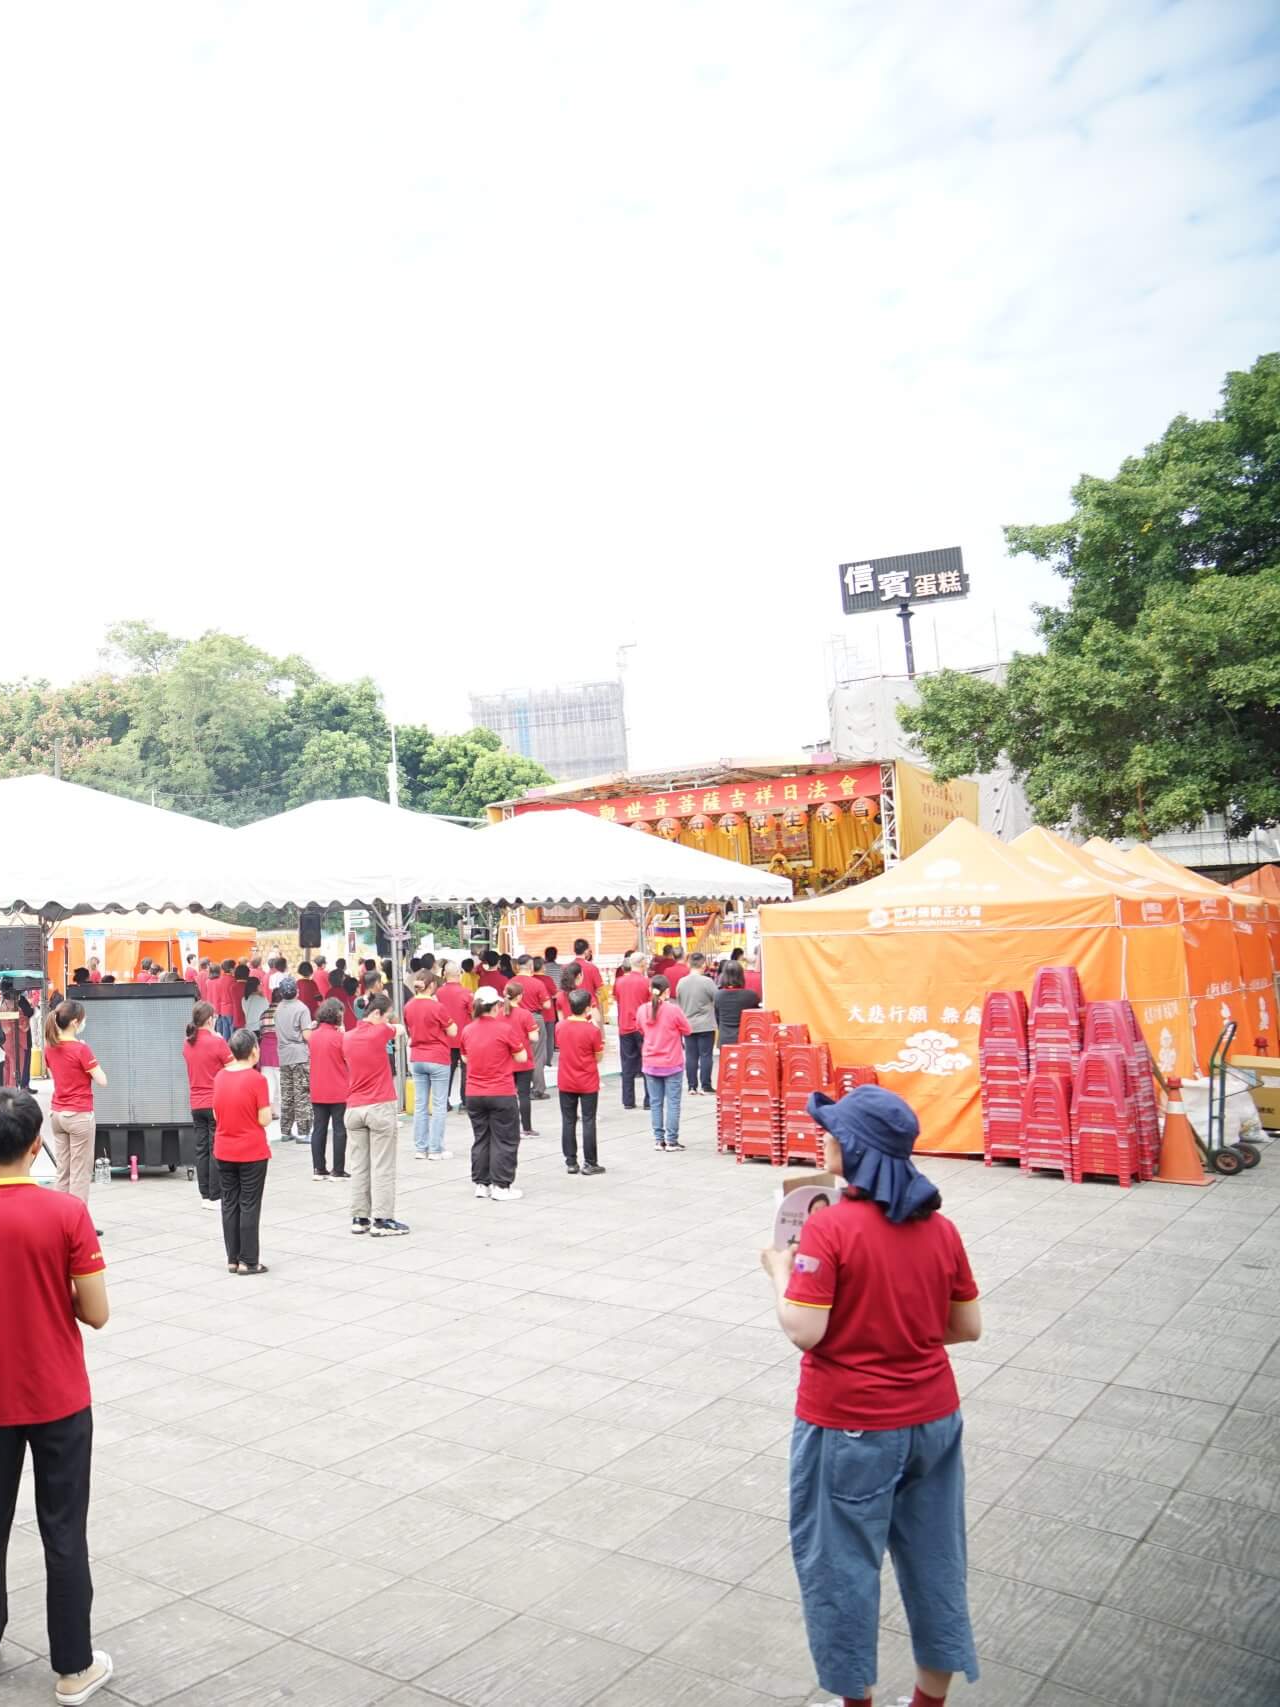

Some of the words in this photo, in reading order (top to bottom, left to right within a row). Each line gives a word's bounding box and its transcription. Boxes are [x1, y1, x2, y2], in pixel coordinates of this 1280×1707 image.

[598, 775, 859, 822] 觀世音菩薩吉祥日法會
[847, 1004, 929, 1024] 大悲行願
